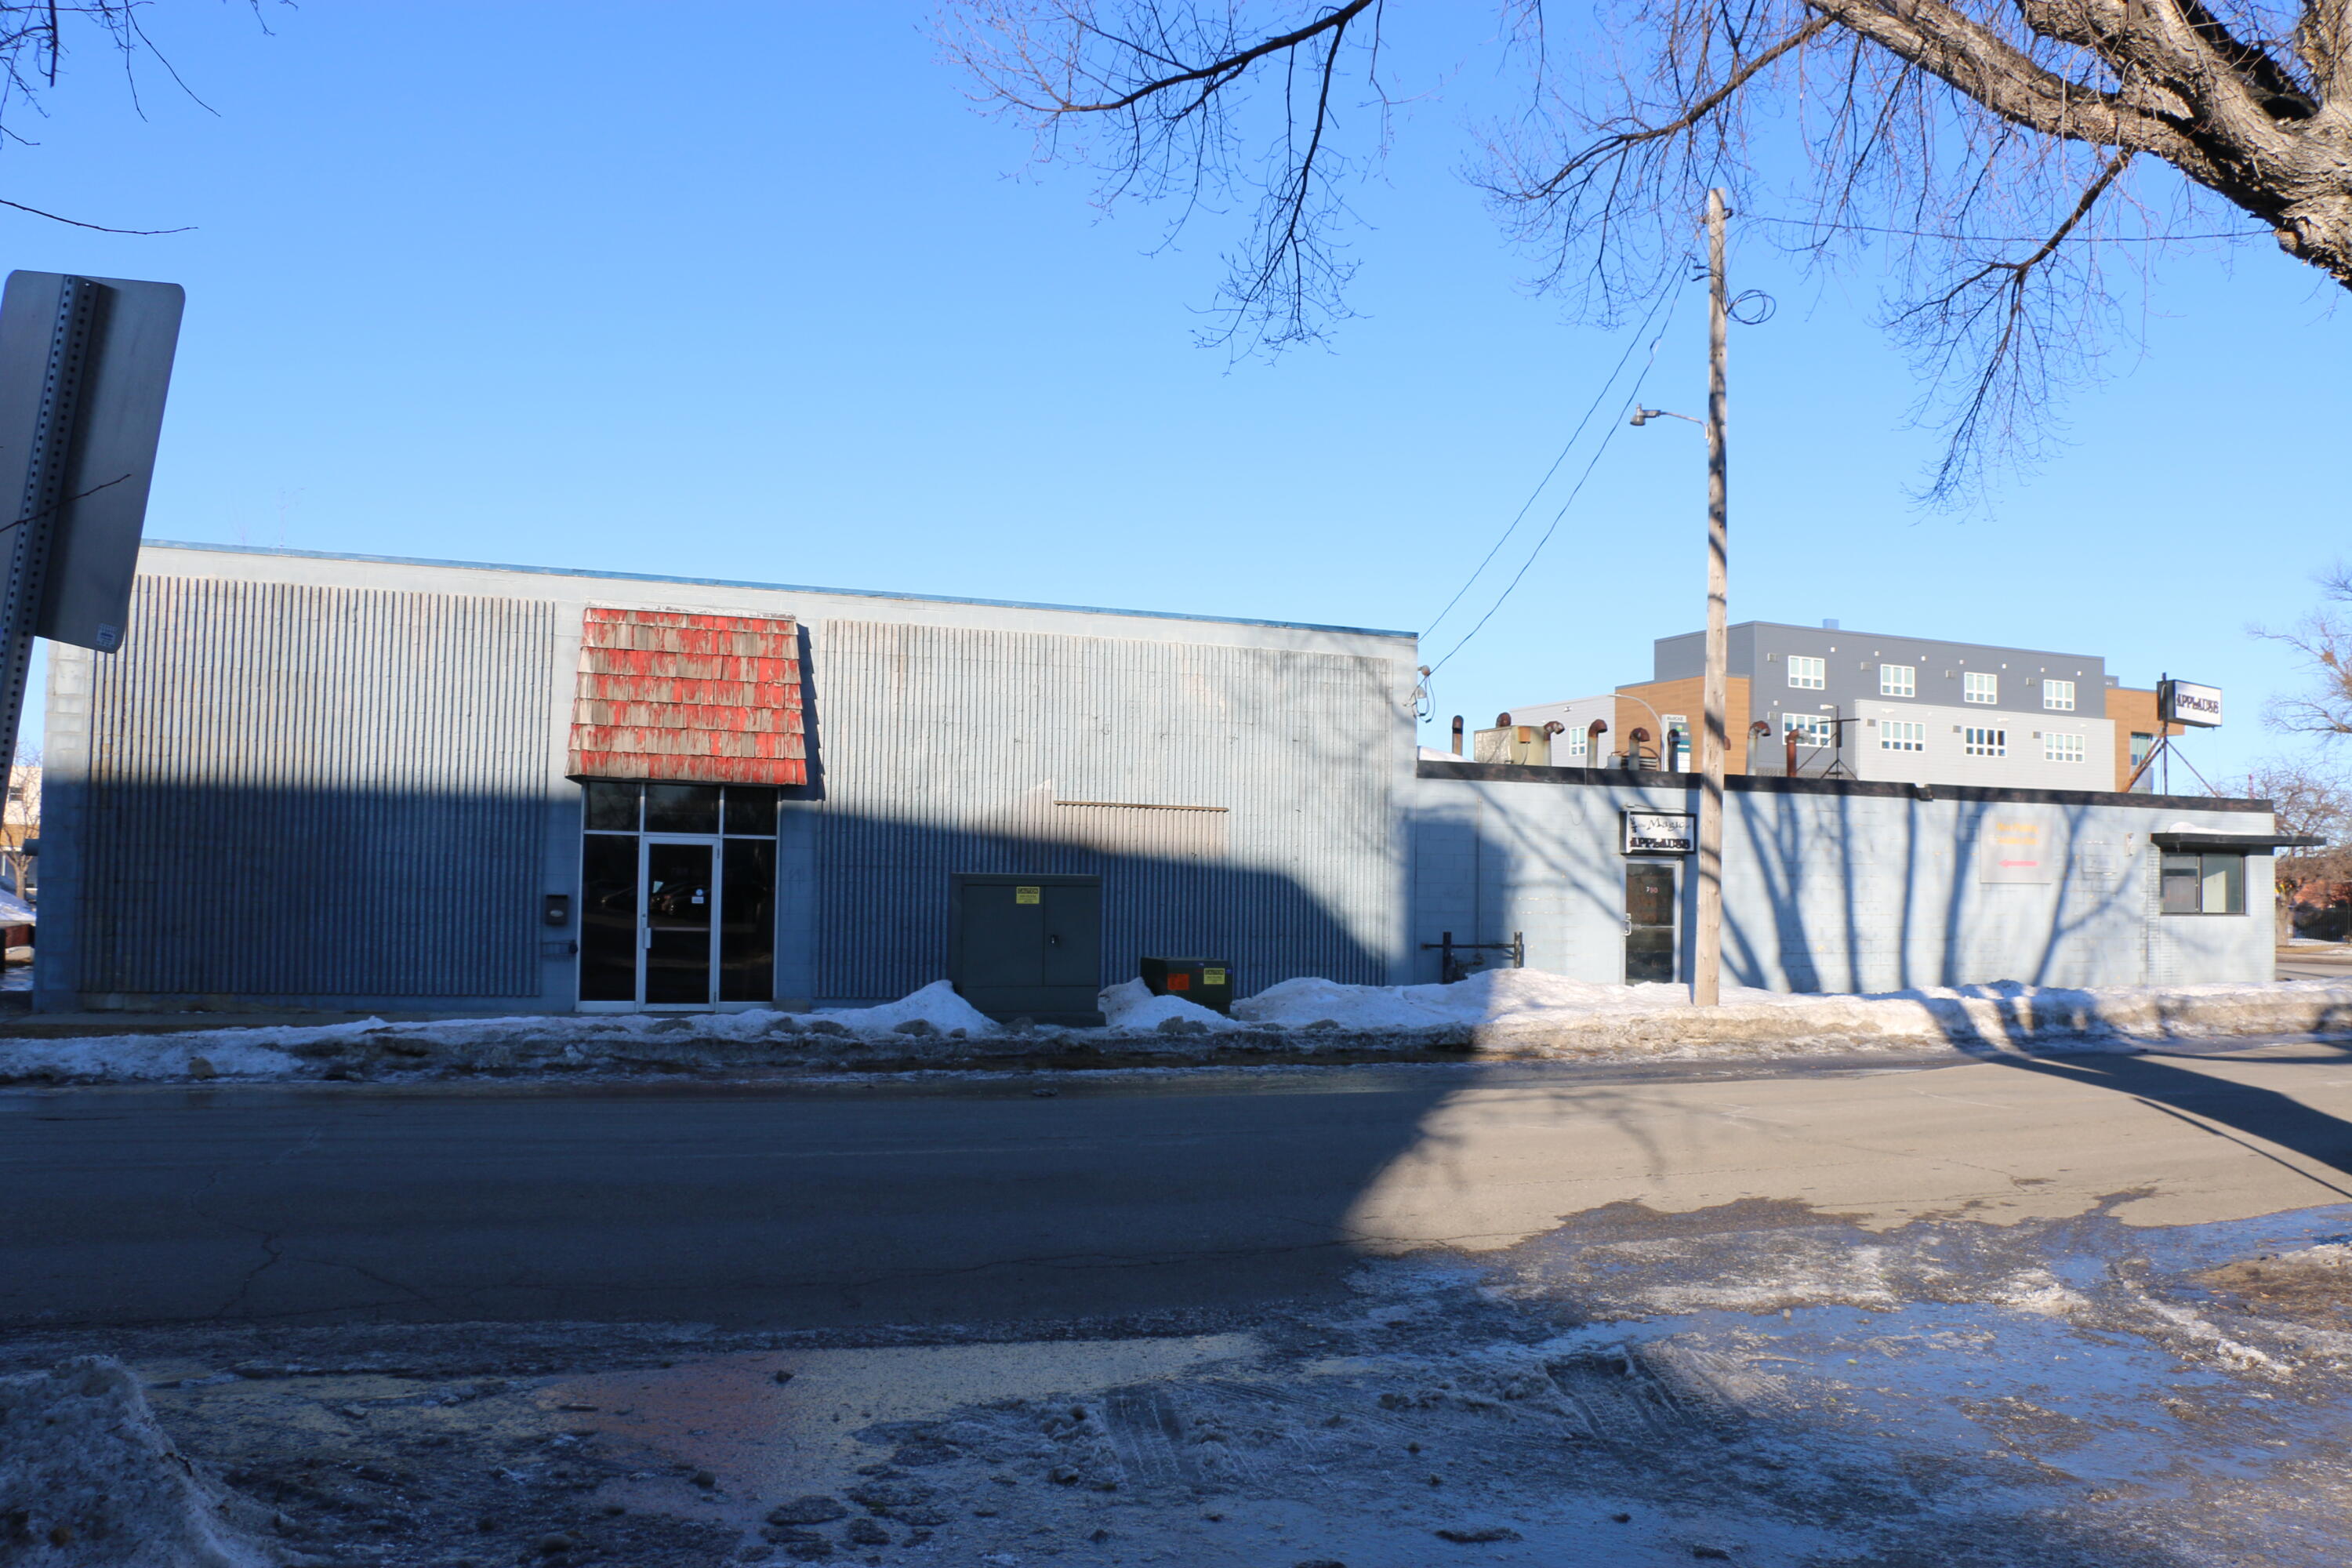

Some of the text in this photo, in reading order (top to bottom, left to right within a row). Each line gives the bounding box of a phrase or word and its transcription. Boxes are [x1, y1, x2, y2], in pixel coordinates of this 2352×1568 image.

[2176, 694, 2218, 713] APPLAUSE
[1646, 818, 1685, 832] Magic
[1630, 837, 1690, 849] APPLAUSE
